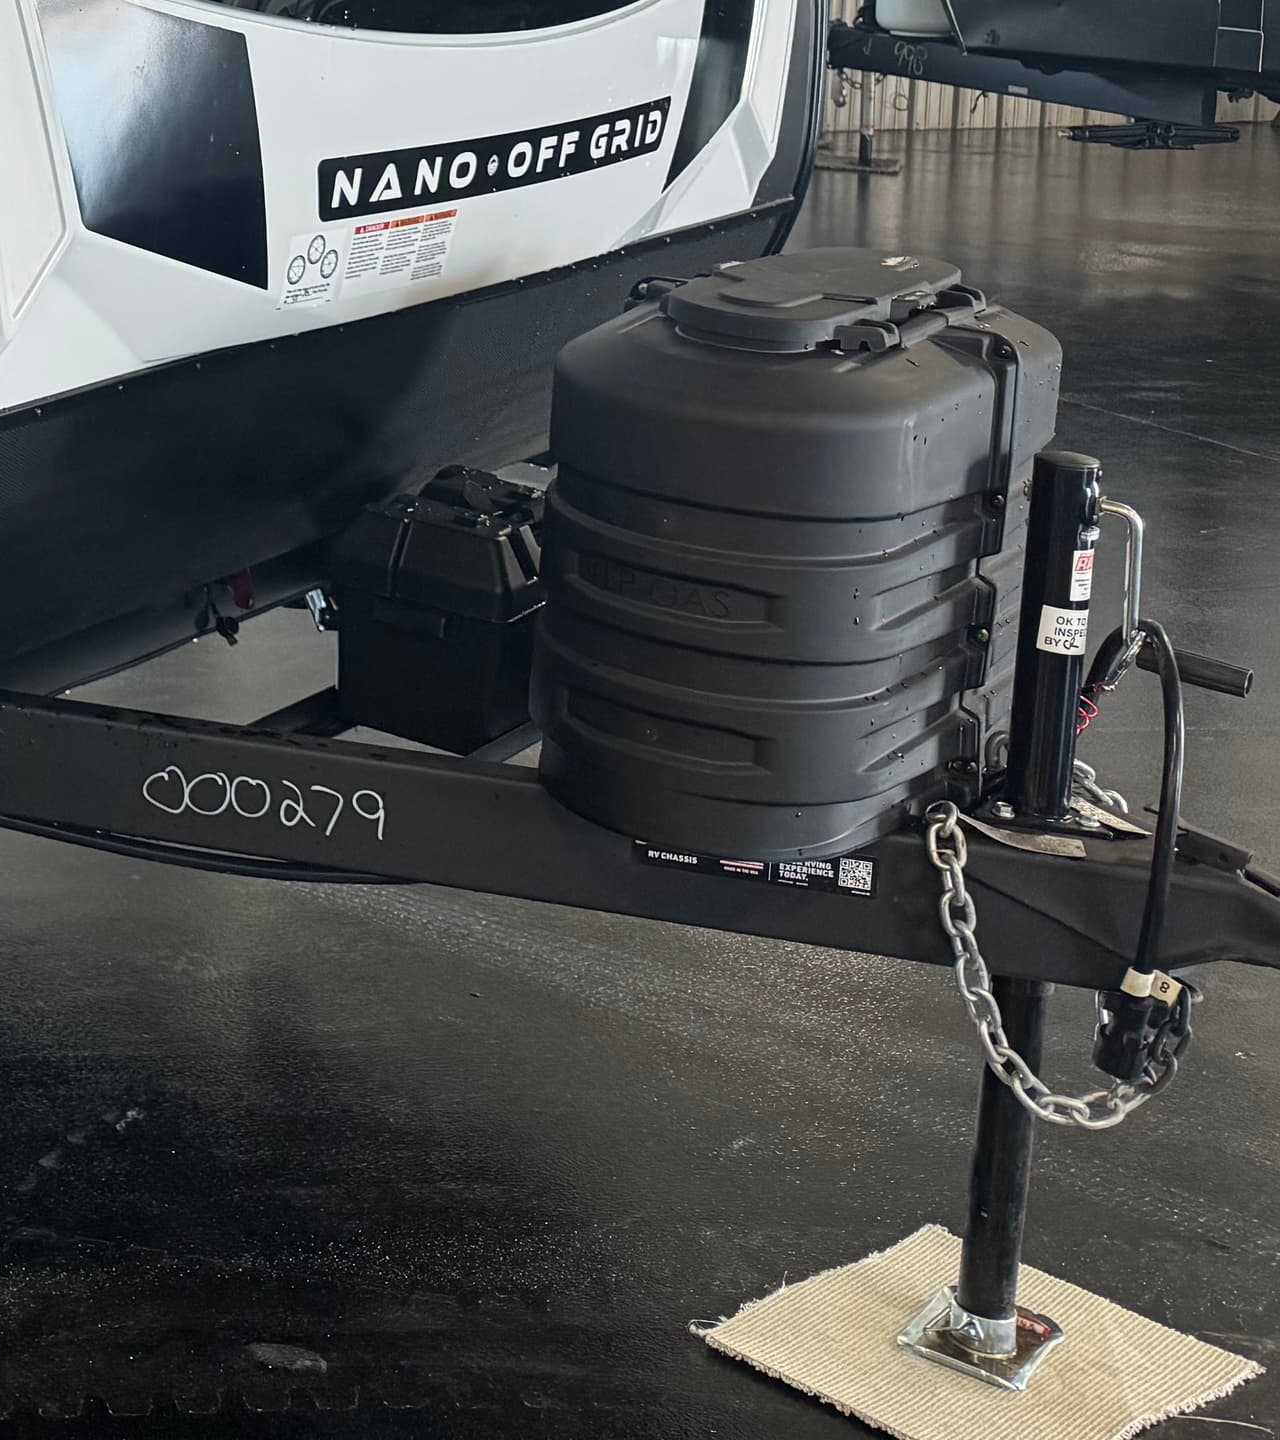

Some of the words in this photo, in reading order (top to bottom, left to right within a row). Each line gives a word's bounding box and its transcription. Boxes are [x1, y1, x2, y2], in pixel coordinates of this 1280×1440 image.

[329, 151, 477, 210] NANO
[506, 129, 581, 180] OFF
[588, 108, 665, 161] GRID
[1055, 616, 1074, 626] OK
[1054, 626, 1087, 638] INSPE
[1044, 636, 1062, 647] BY
[142, 764, 387, 841] 000279
[648, 849, 661, 859] RV
[661, 851, 699, 865] CHASSIS
[779, 863, 835, 878] EXPERIENCE
[779, 871, 809, 882] TODAY.
